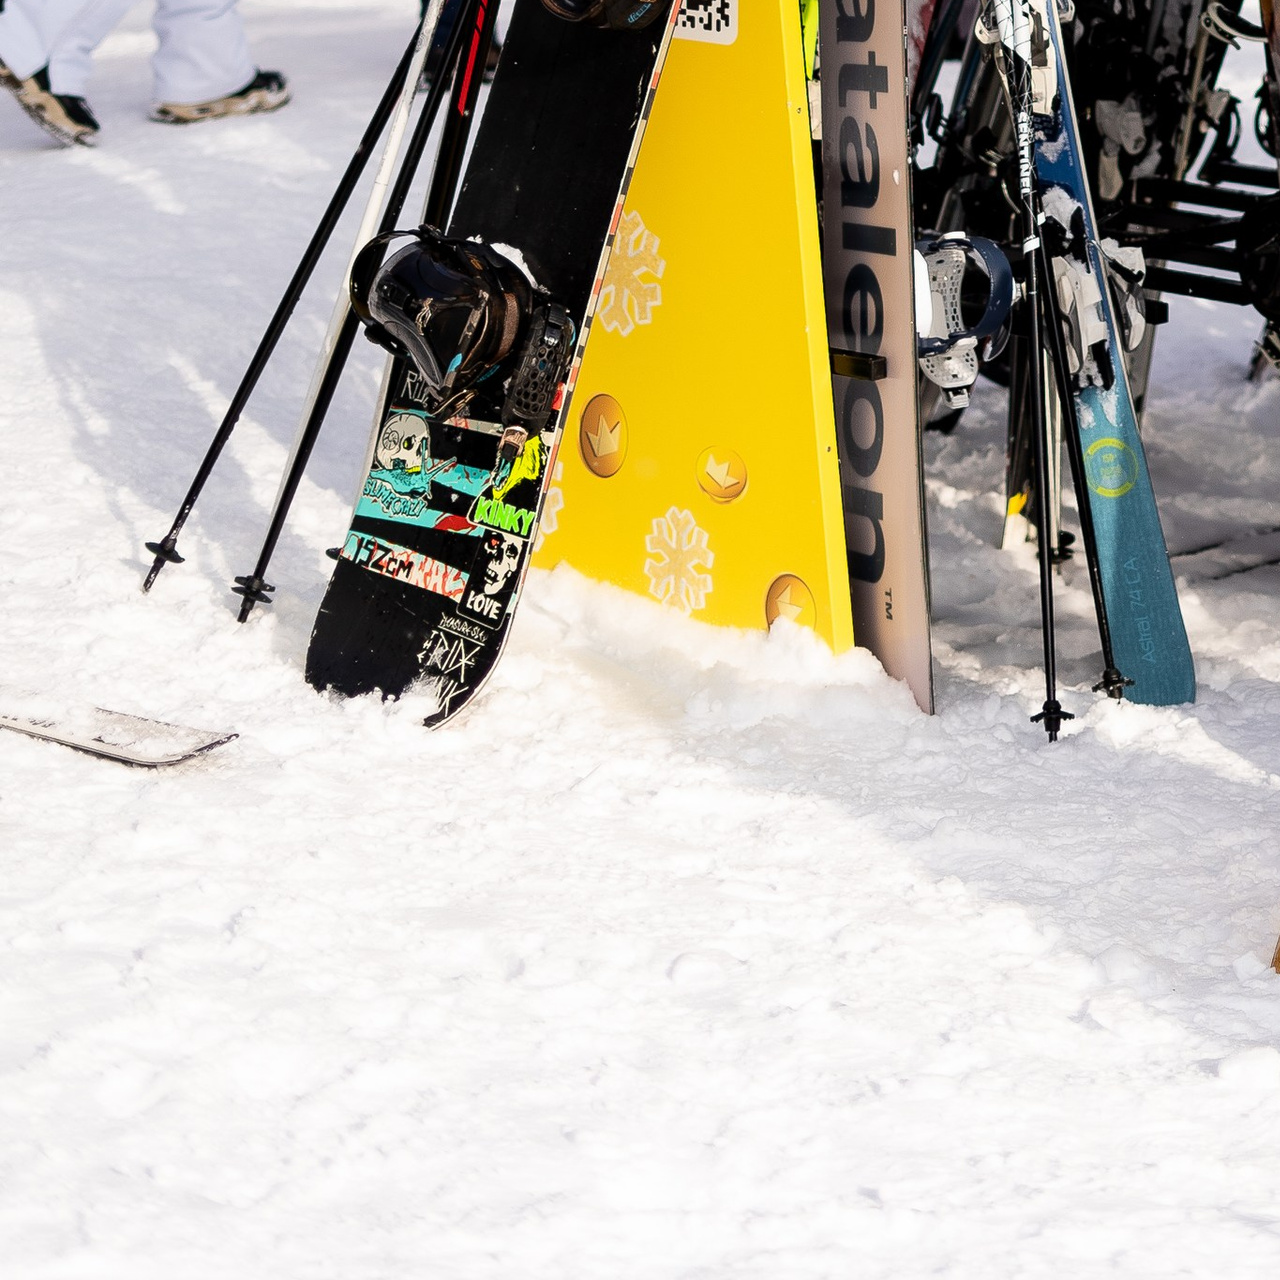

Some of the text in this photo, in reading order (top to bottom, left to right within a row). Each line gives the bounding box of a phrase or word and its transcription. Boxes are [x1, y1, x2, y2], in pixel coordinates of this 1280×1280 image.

[1017, 111, 1032, 197] SENTINEL
[474, 496, 537, 537] KINKY
[465, 589, 503, 621] LOVE
